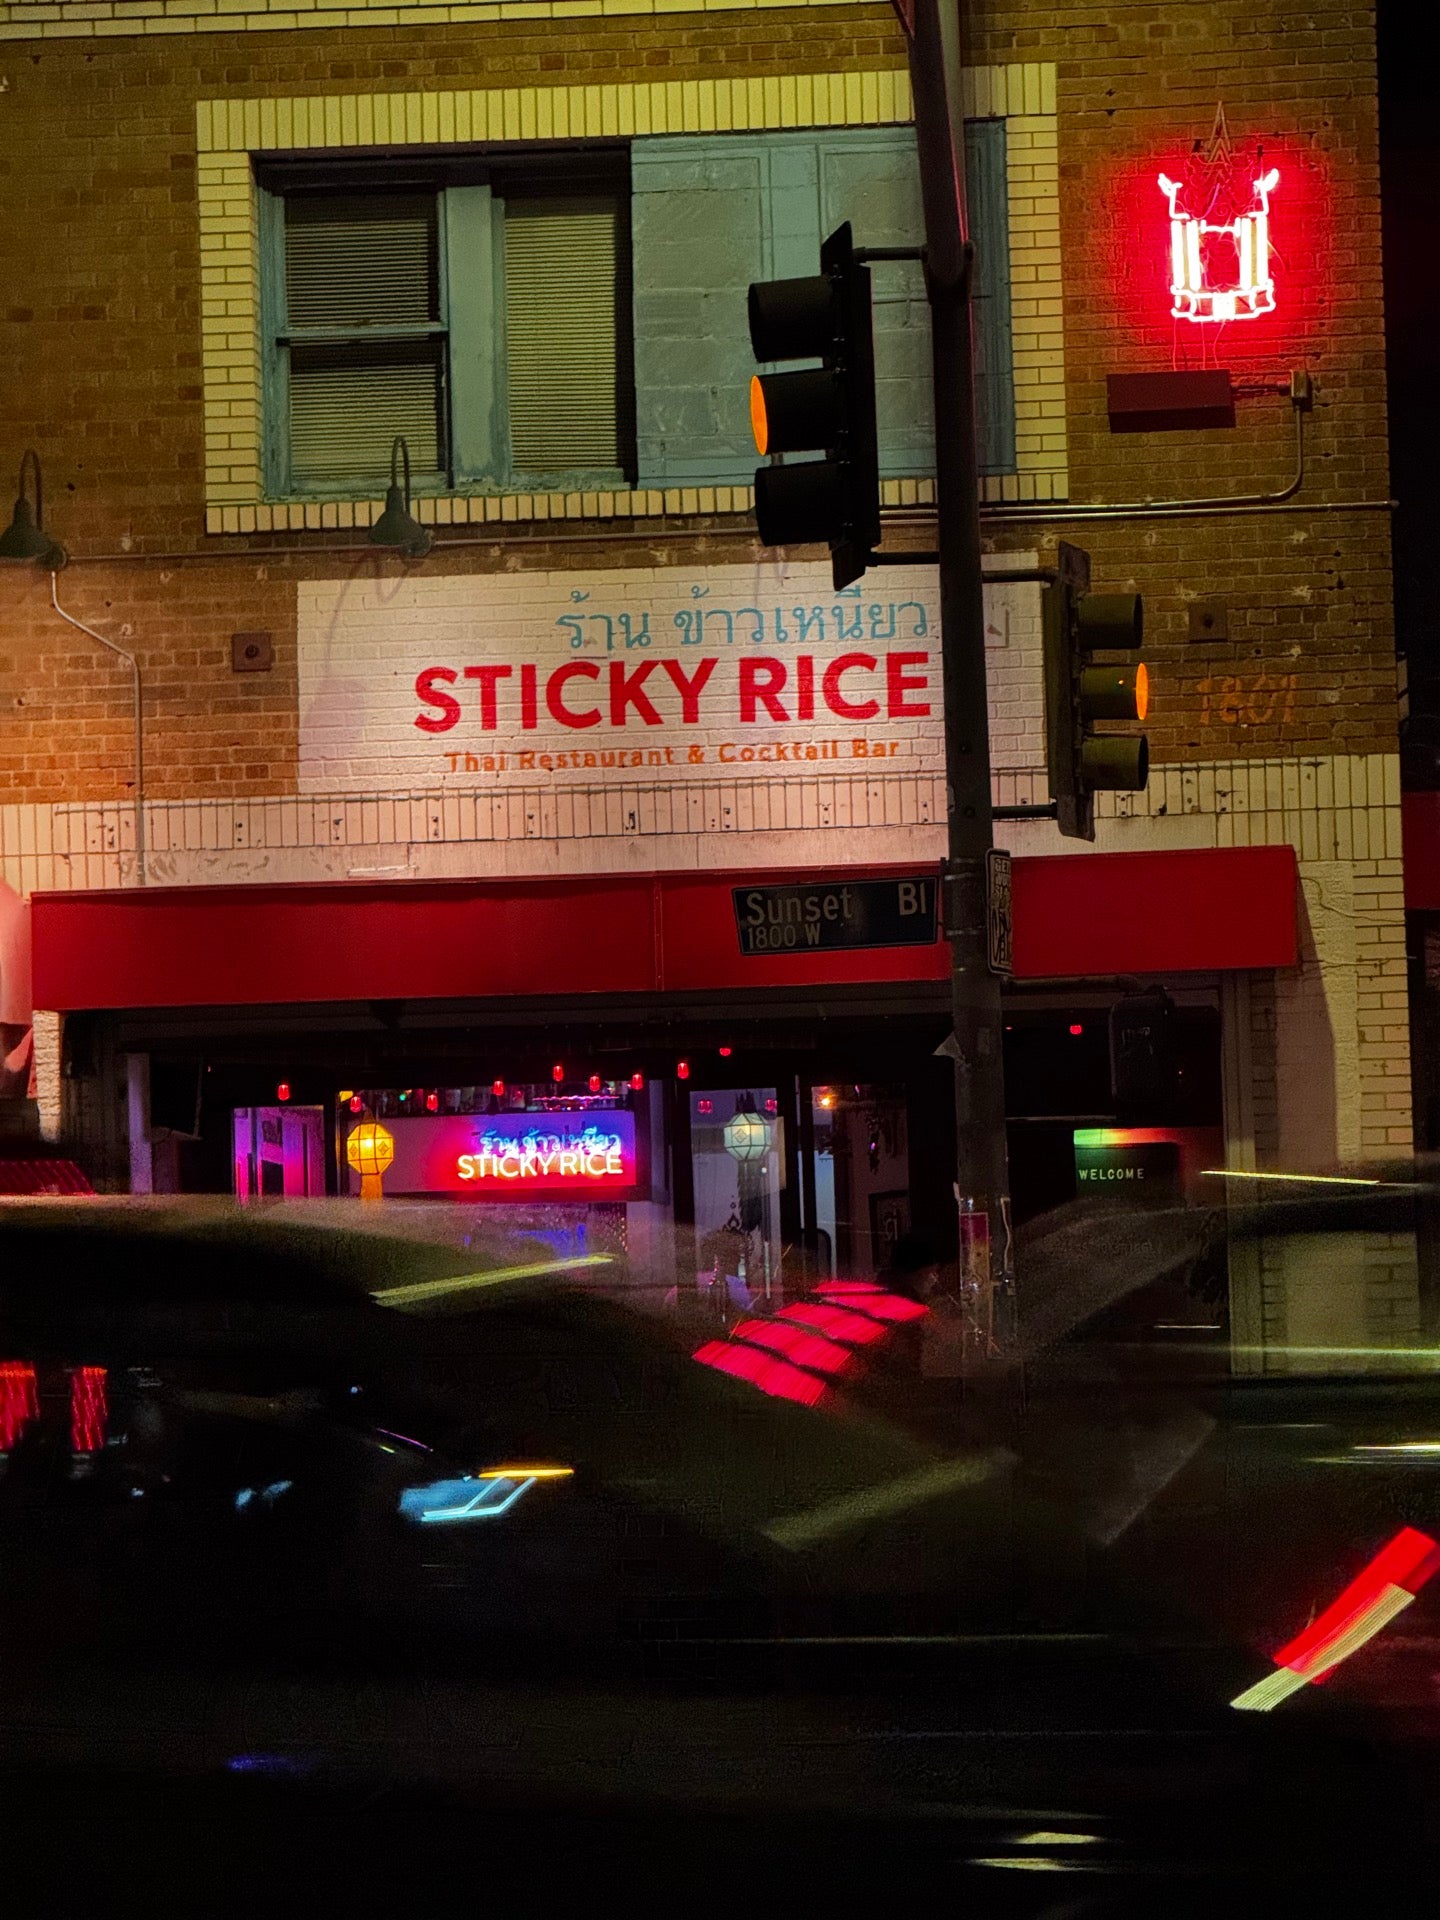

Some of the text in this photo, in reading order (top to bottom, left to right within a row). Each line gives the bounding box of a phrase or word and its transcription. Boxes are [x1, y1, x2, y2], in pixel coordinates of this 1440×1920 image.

[556, 590, 652, 650] ร้าน
[413, 651, 932, 734] STICKY RICE
[445, 739, 900, 772] Thai Restaurant & Cocktail Bar
[746, 882, 928, 926] Sunset Bl
[748, 923, 821, 949] 1800 W
[457, 1152, 623, 1179] STICKY RICE
[1079, 1169, 1144, 1180] WELCOME
